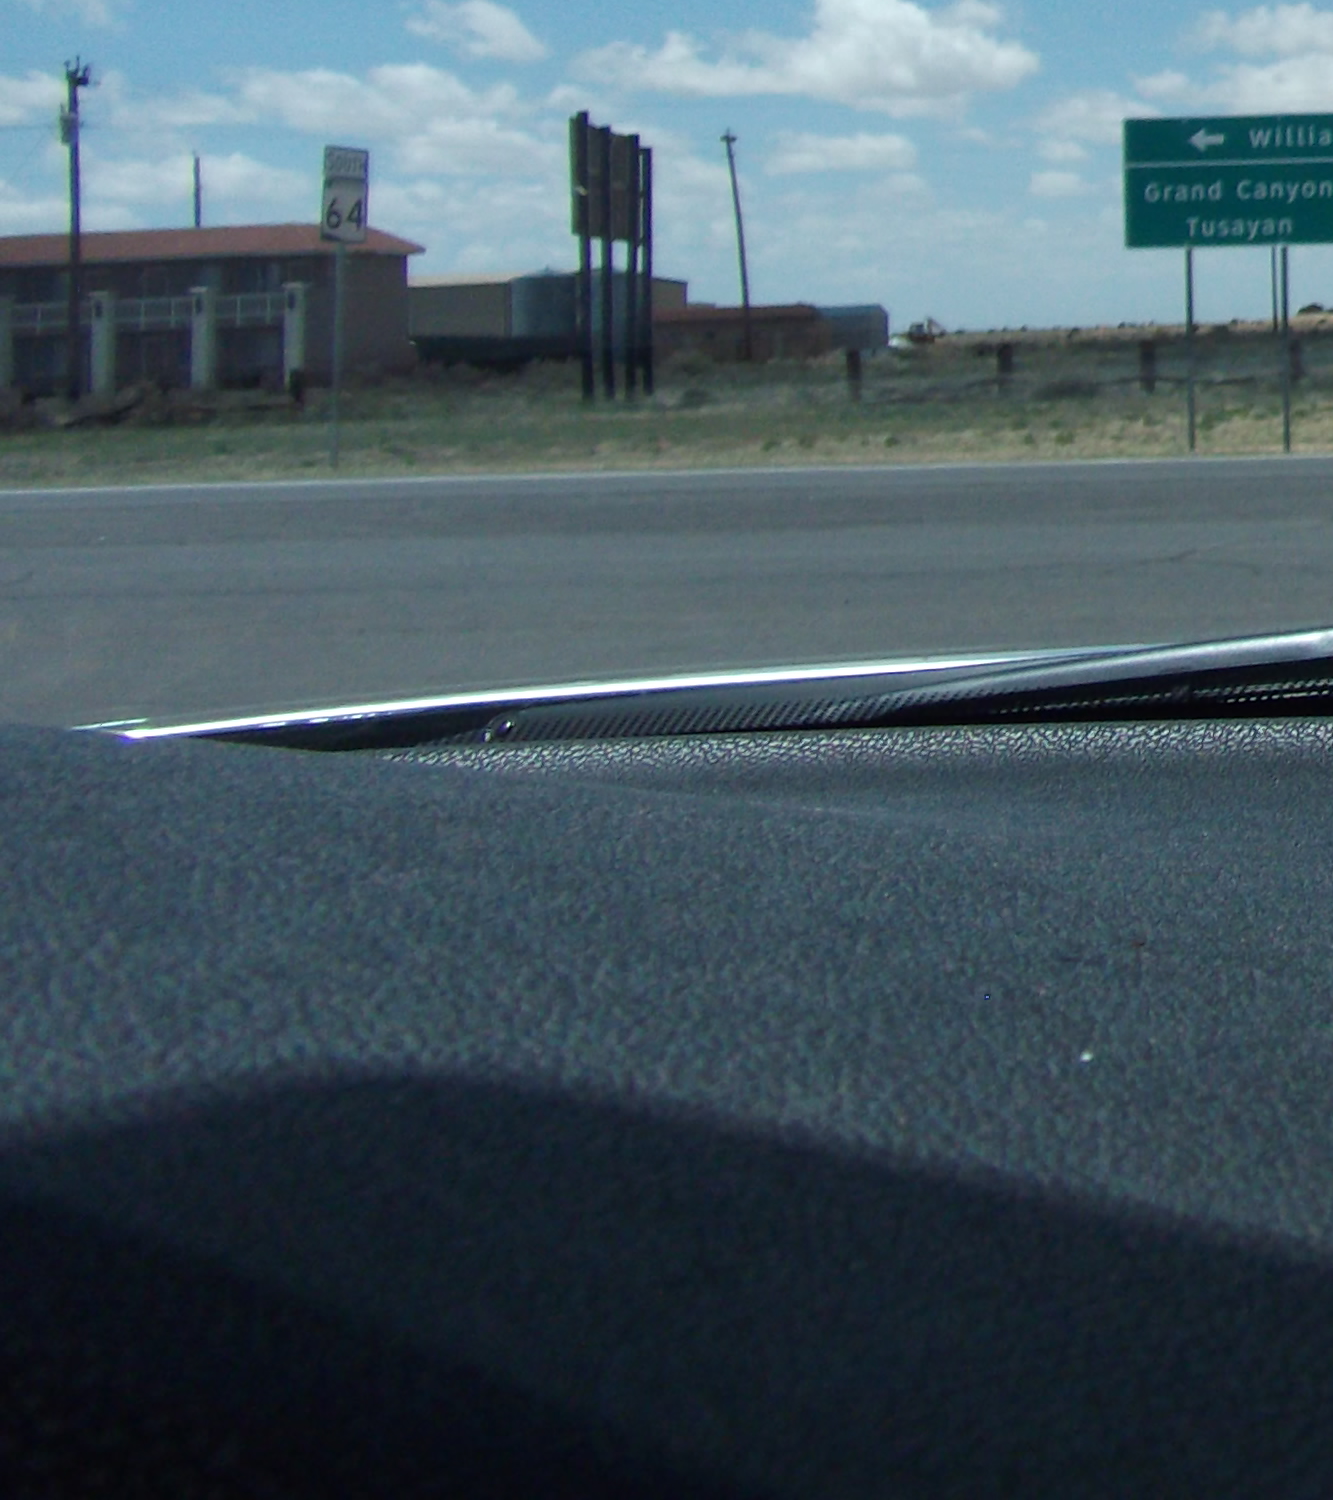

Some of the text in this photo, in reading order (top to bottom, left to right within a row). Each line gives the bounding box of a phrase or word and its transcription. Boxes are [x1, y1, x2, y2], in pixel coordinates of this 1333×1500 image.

[1144, 179, 1333, 204] Grand Canyon
[326, 197, 363, 231] 64
[1186, 216, 1293, 240] Tusayan
